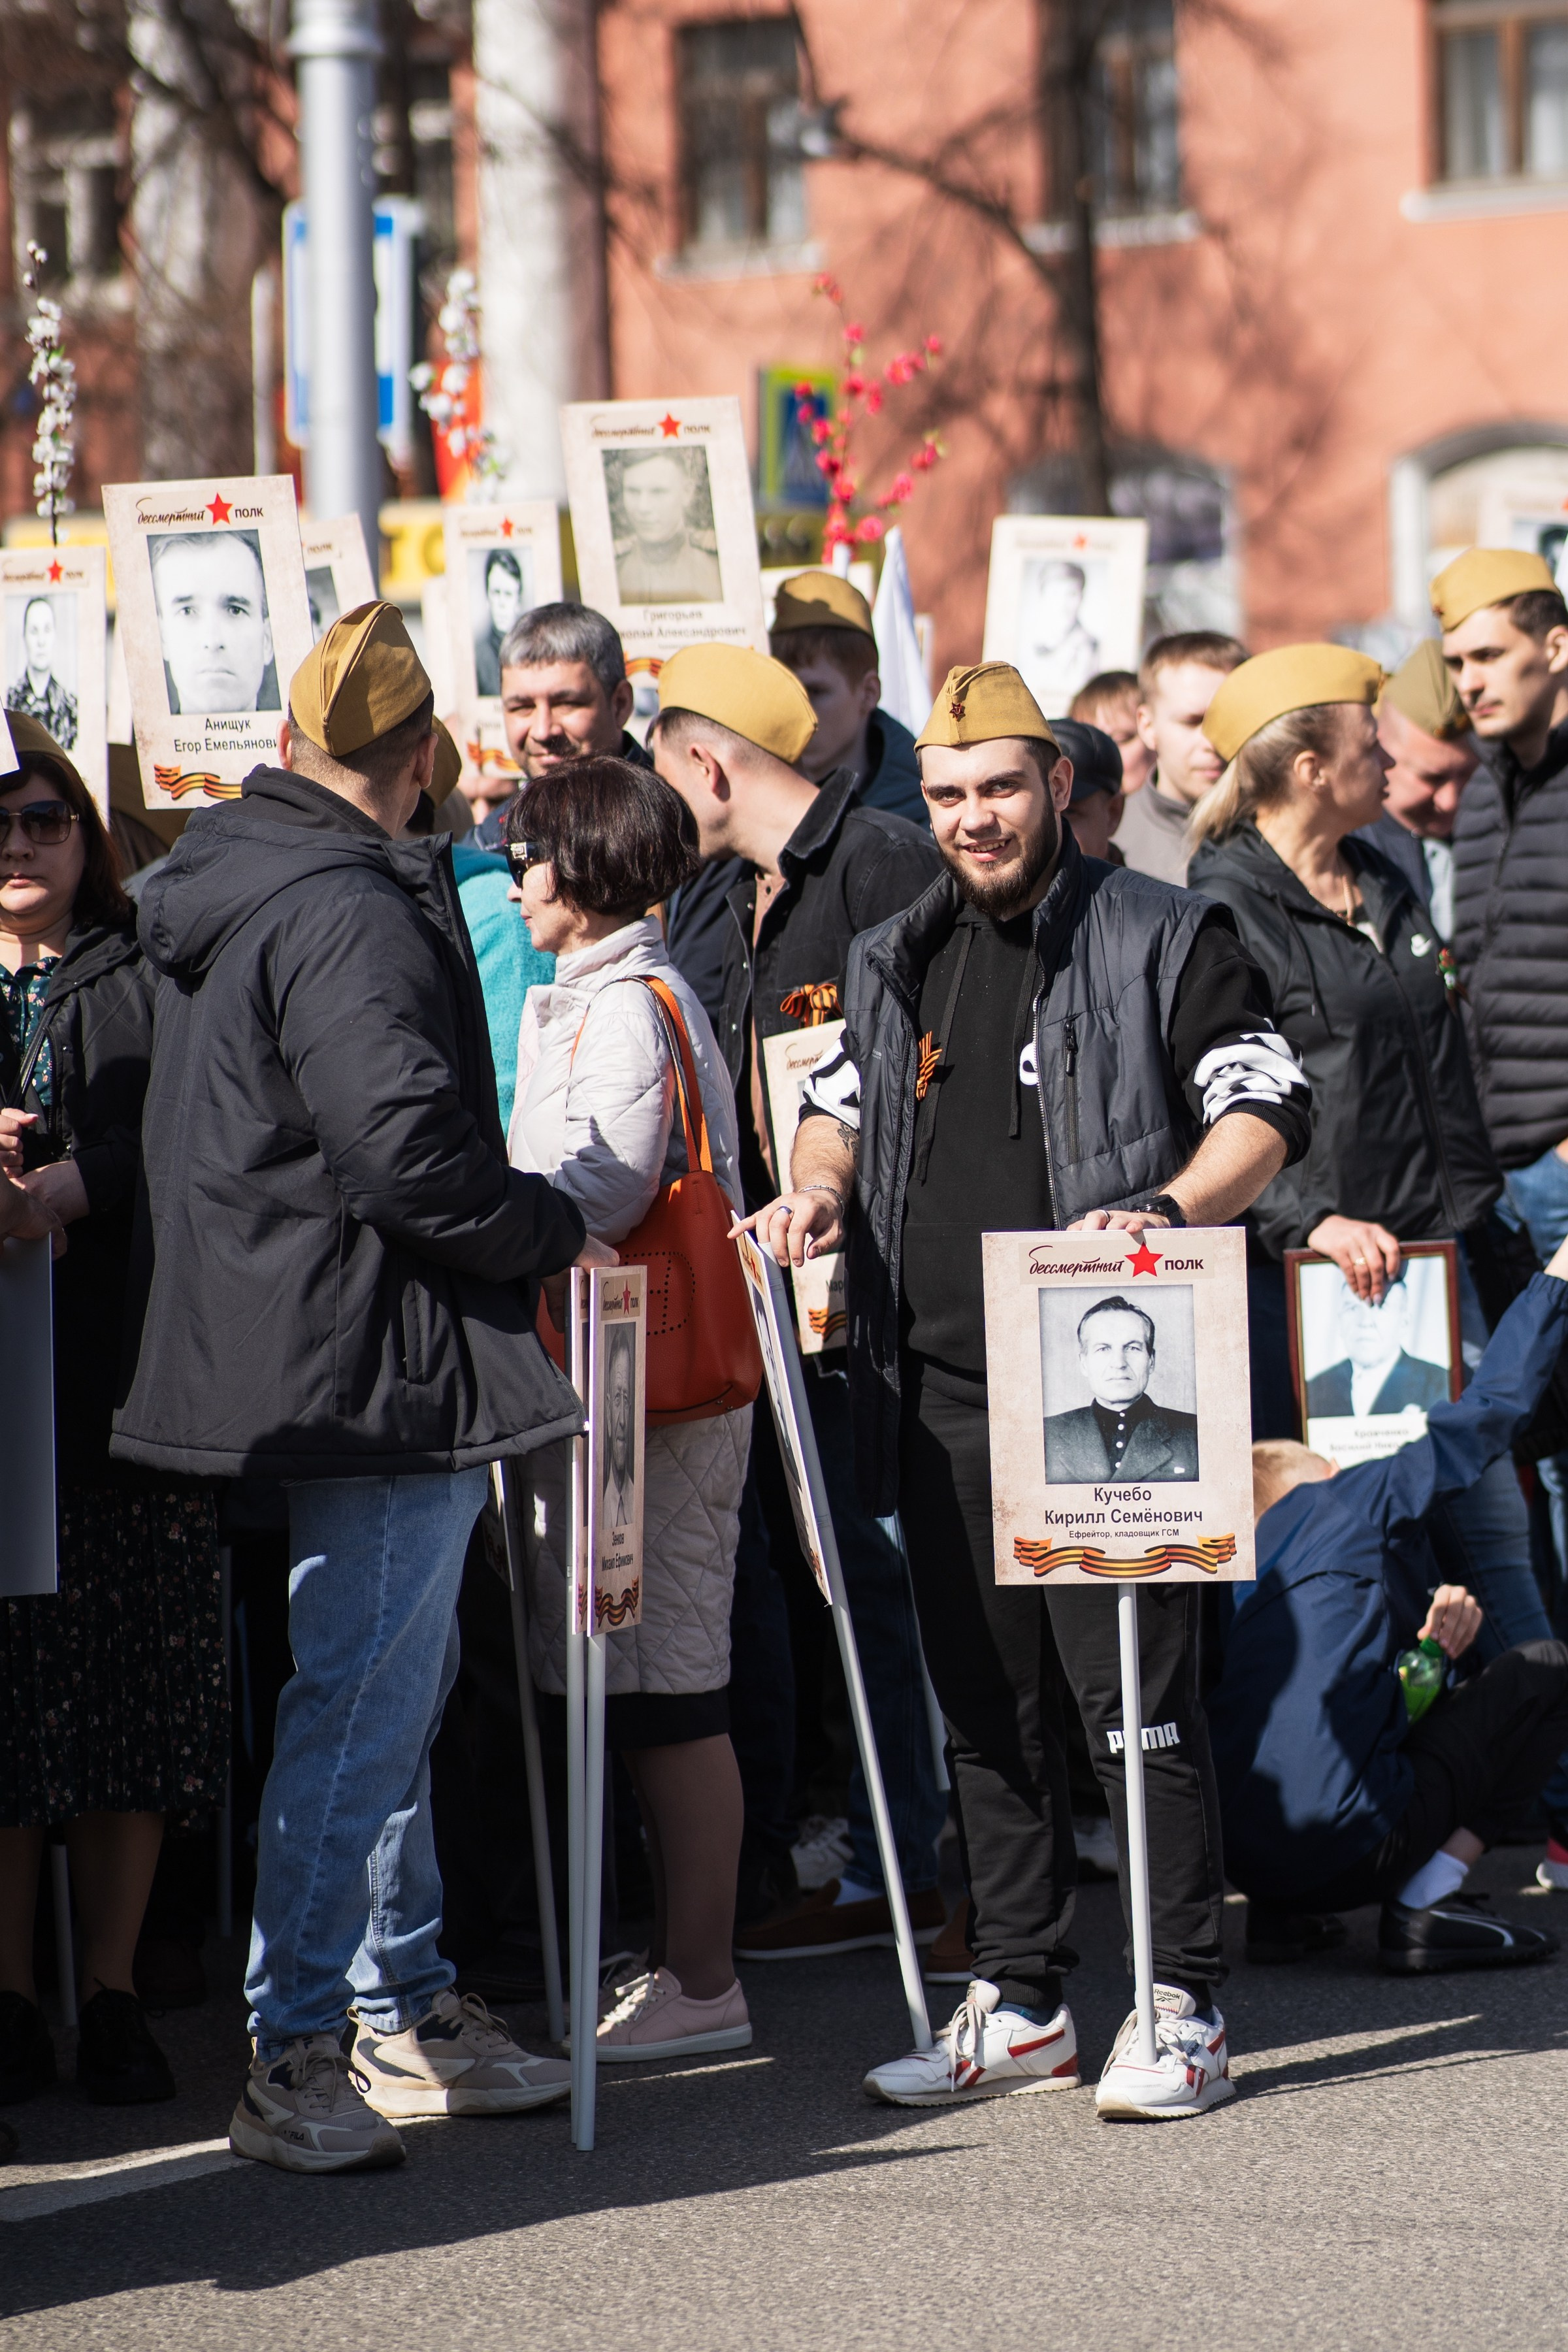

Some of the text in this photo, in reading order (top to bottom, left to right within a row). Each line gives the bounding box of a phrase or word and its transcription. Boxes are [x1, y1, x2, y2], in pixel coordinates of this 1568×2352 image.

[135, 497, 205, 526] бессмертный
[643, 609, 704, 623] Григорьев
[657, 625, 746, 640] Александрович
[205, 718, 252, 733] Анищук
[174, 738, 278, 755] Егор Емельянови
[1028, 1245, 1125, 1277] бессмертный
[1094, 1486, 1152, 1505] Кучебо
[1045, 1508, 1203, 1527] Кирилл Семёнович
[1069, 1528, 1180, 1539] Ефрейтор, кладовщик ГСМ
[1106, 1722, 1181, 1754] PMA
[1154, 1988, 1181, 1999] Reebok
[289, 2131, 304, 2141] FILA
